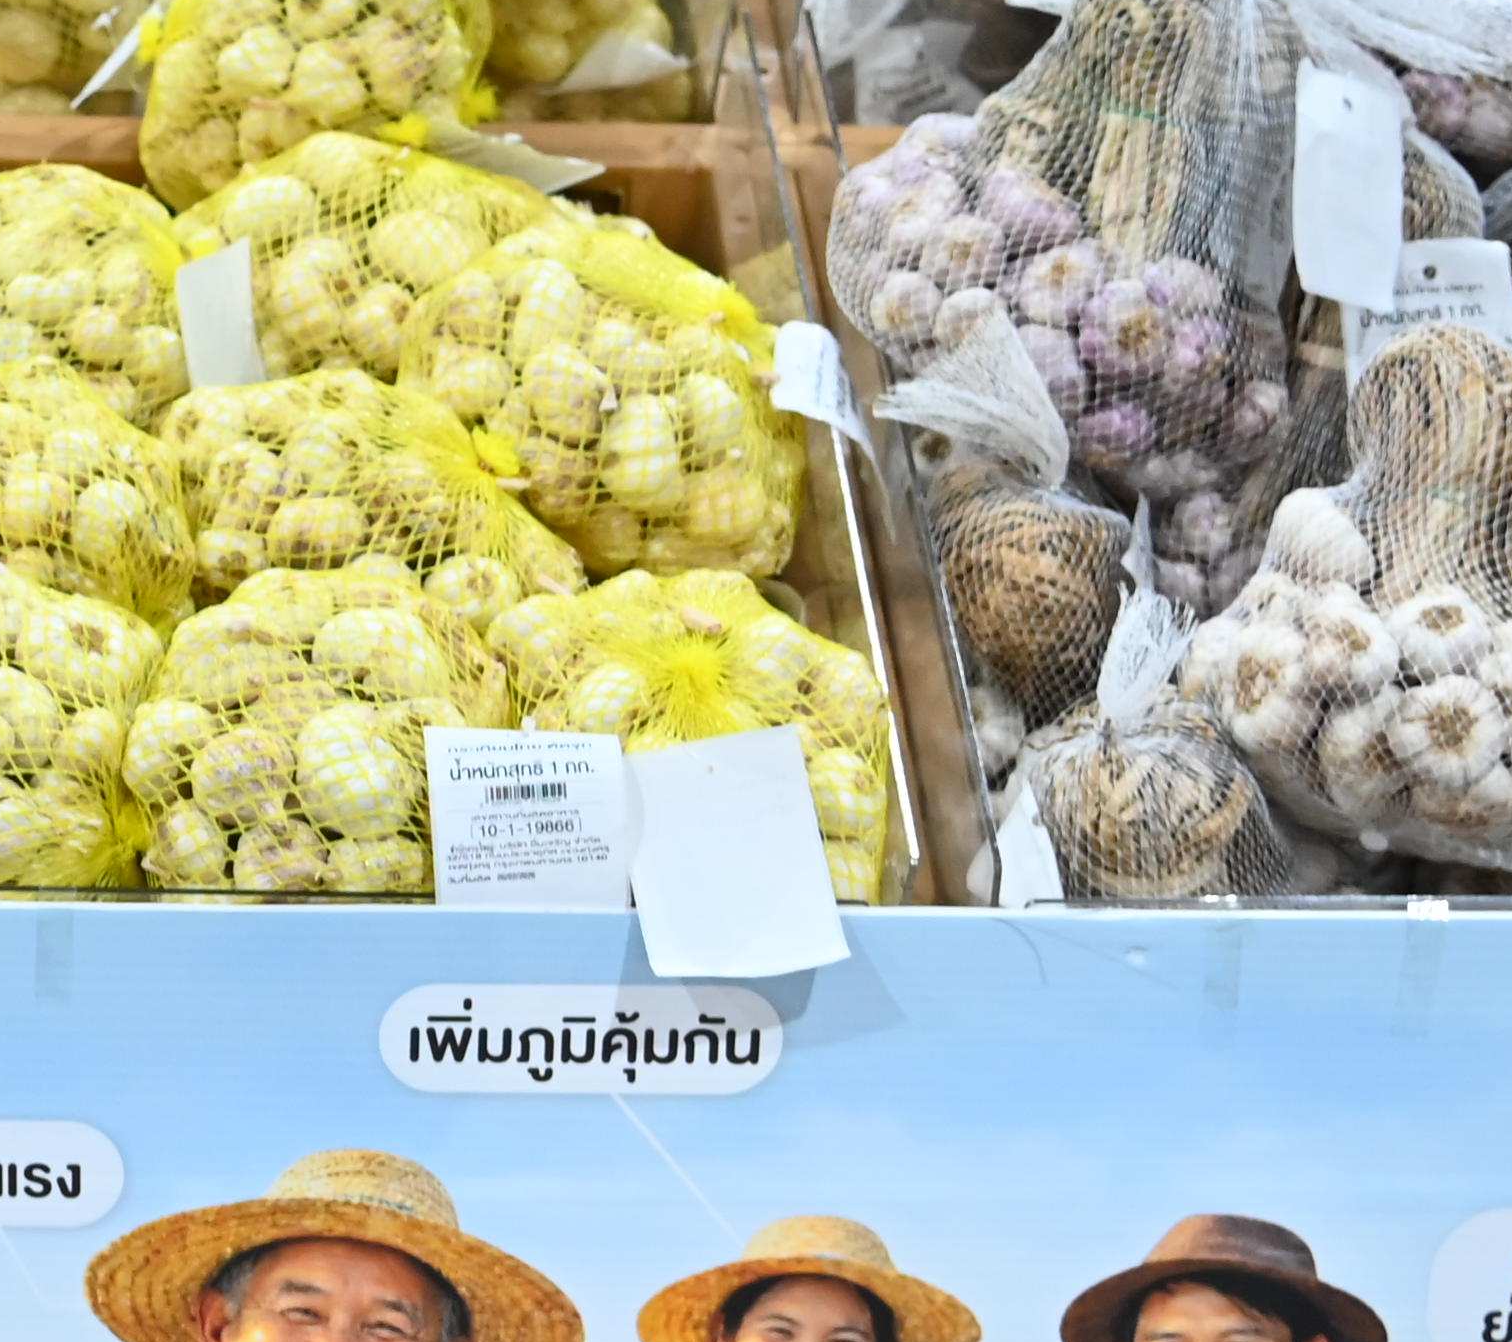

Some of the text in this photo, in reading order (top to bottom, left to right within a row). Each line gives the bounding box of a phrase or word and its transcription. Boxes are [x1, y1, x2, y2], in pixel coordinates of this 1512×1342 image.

[550, 761, 557, 775] 1
[565, 760, 595, 775] กก.
[407, 997, 762, 1083] เพิ่มภูมิคุ้มกัน
